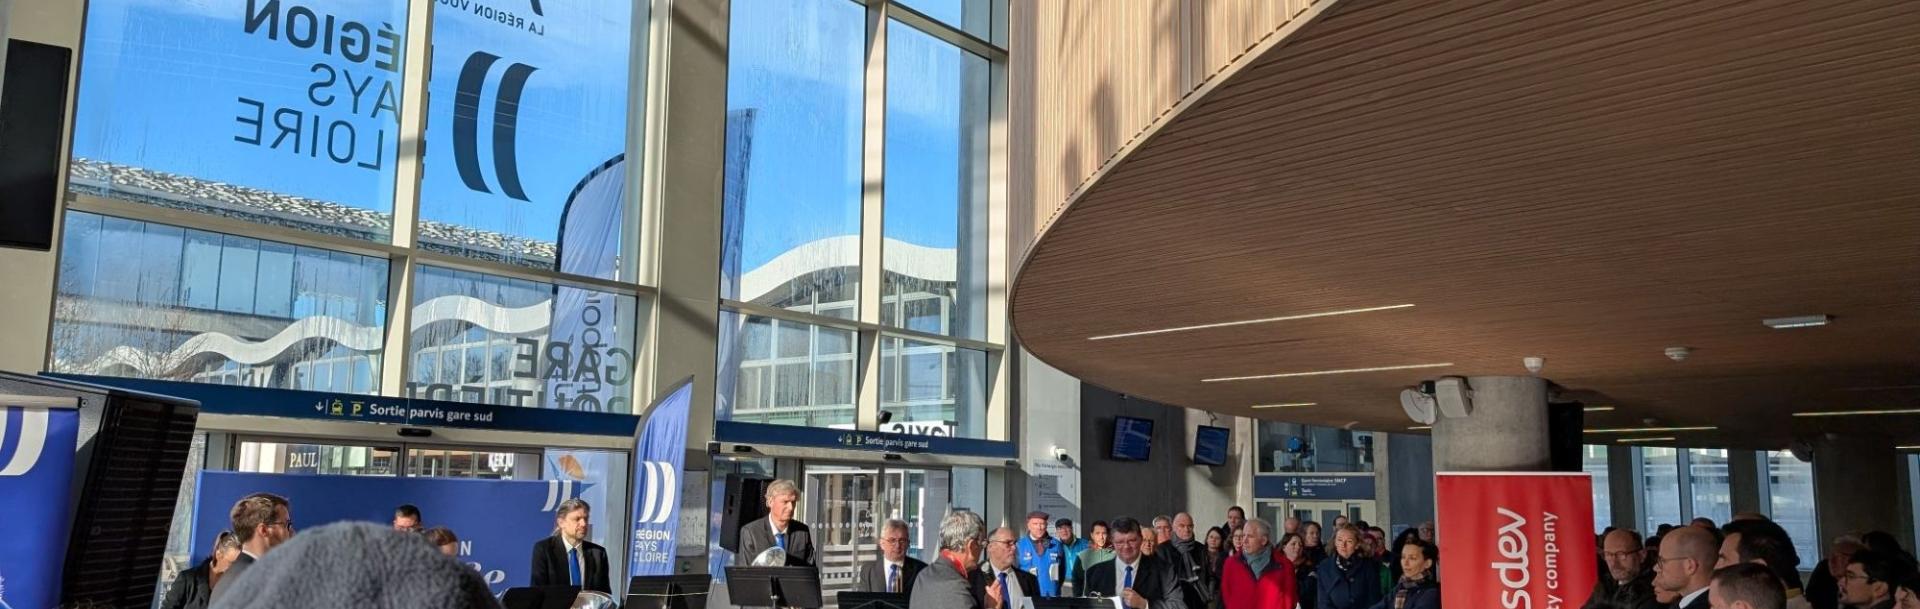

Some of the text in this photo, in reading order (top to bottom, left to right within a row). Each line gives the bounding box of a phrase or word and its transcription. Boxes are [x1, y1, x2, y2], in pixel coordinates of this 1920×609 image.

[369, 403, 405, 417] Sortie
[410, 408, 444, 419] parvis
[446, 411, 471, 421] gare
[474, 411, 493, 422] sud
[865, 436, 884, 445] Sortie
[885, 439, 904, 447] parvis
[904, 441, 918, 449] gare
[918, 440, 928, 448] sud
[290, 452, 318, 468] PAUL
[639, 551, 669, 563] LOIRE
[1543, 511, 1560, 589] company
